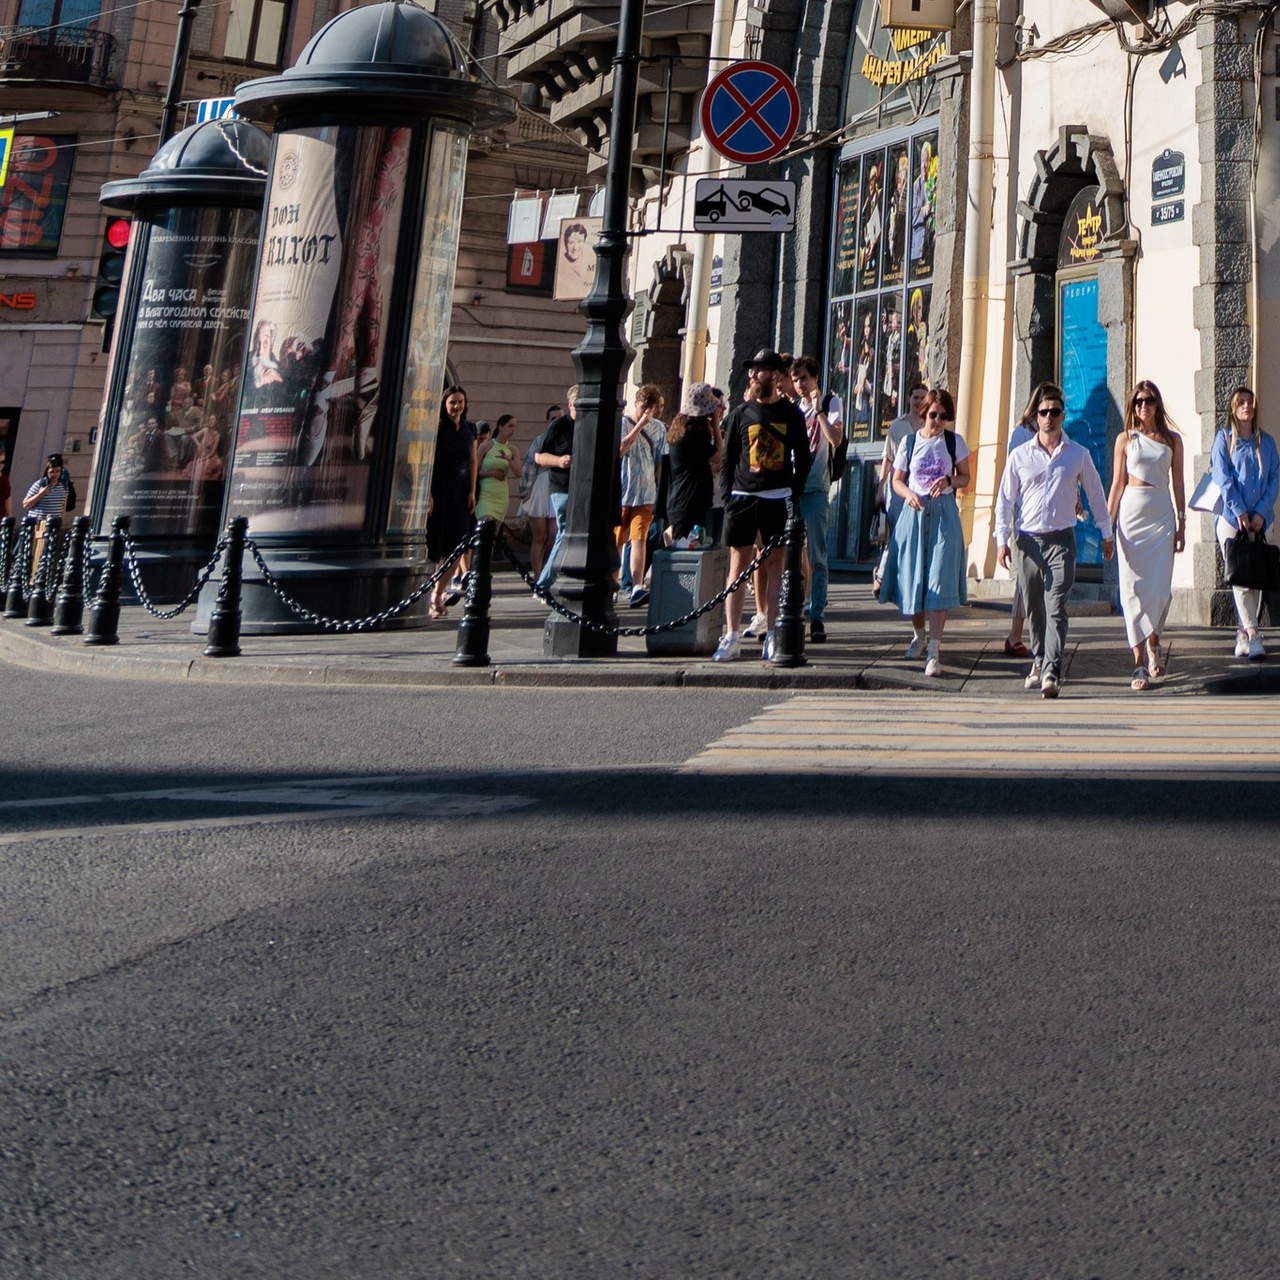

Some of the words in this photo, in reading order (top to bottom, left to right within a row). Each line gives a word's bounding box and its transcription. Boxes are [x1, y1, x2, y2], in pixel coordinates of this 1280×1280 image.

[861, 53, 901, 88] АНДРЕЯ
[1077, 202, 1102, 236] ТЕАТР
[266, 233, 337, 267] КИХОТ
[1066, 285, 1096, 299] РЕПЕРТ
